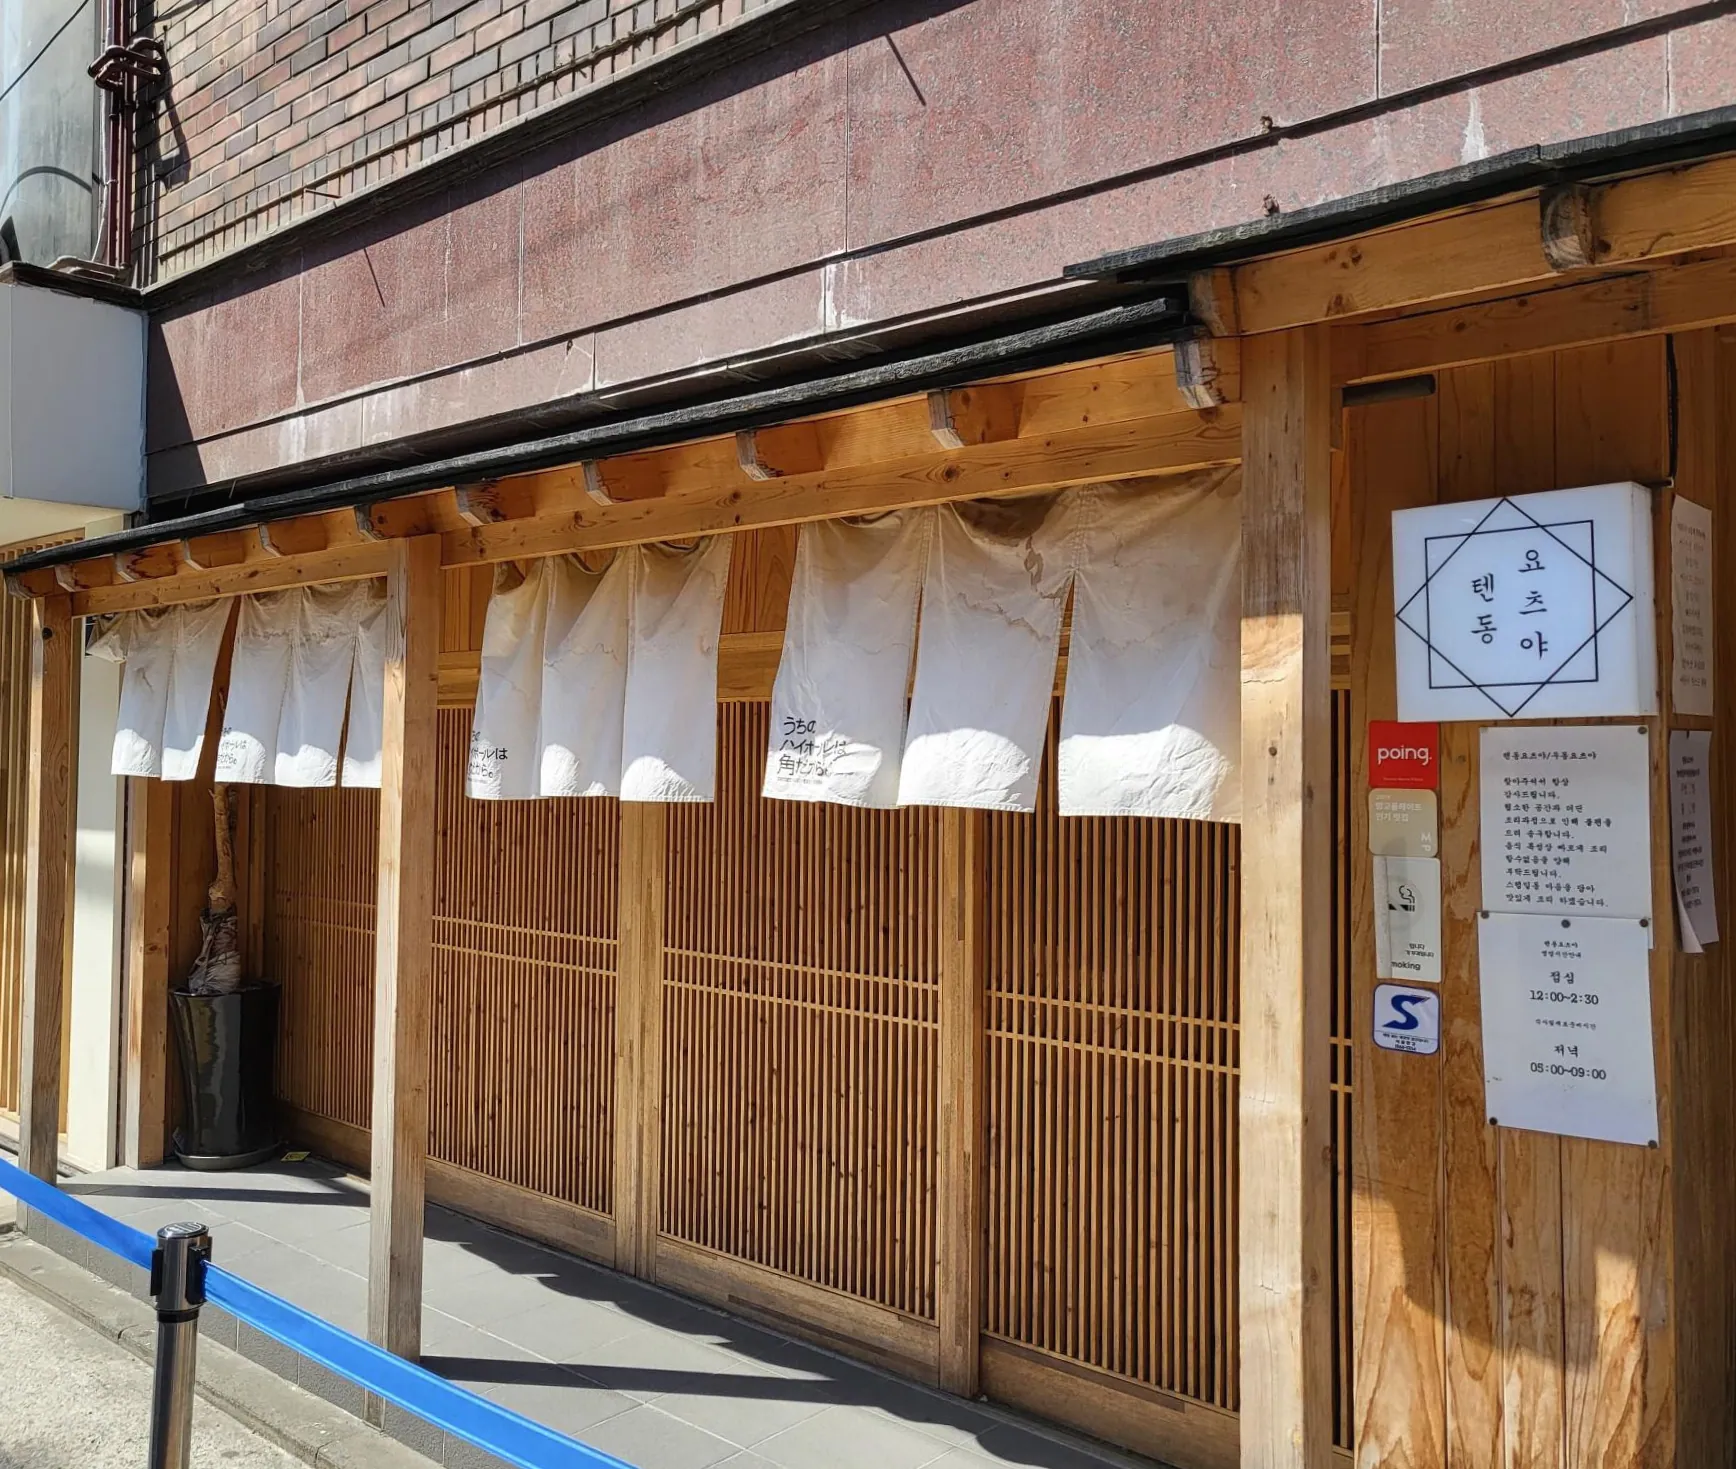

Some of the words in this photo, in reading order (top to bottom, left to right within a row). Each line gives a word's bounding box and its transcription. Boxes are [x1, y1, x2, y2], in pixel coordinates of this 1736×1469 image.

[1471, 573, 1497, 644] 텐동
[1518, 550, 1548, 659] 요츠야
[783, 716, 817, 736] うちの
[1378, 745, 1433, 765] poing.
[1391, 961, 1421, 971] moking
[1551, 971, 1574, 984] 점심
[1530, 990, 1598, 1005] 12:00~2:30
[1555, 1044, 1578, 1058] 저녁
[1531, 1062, 1606, 1080] 05:00~09:00
